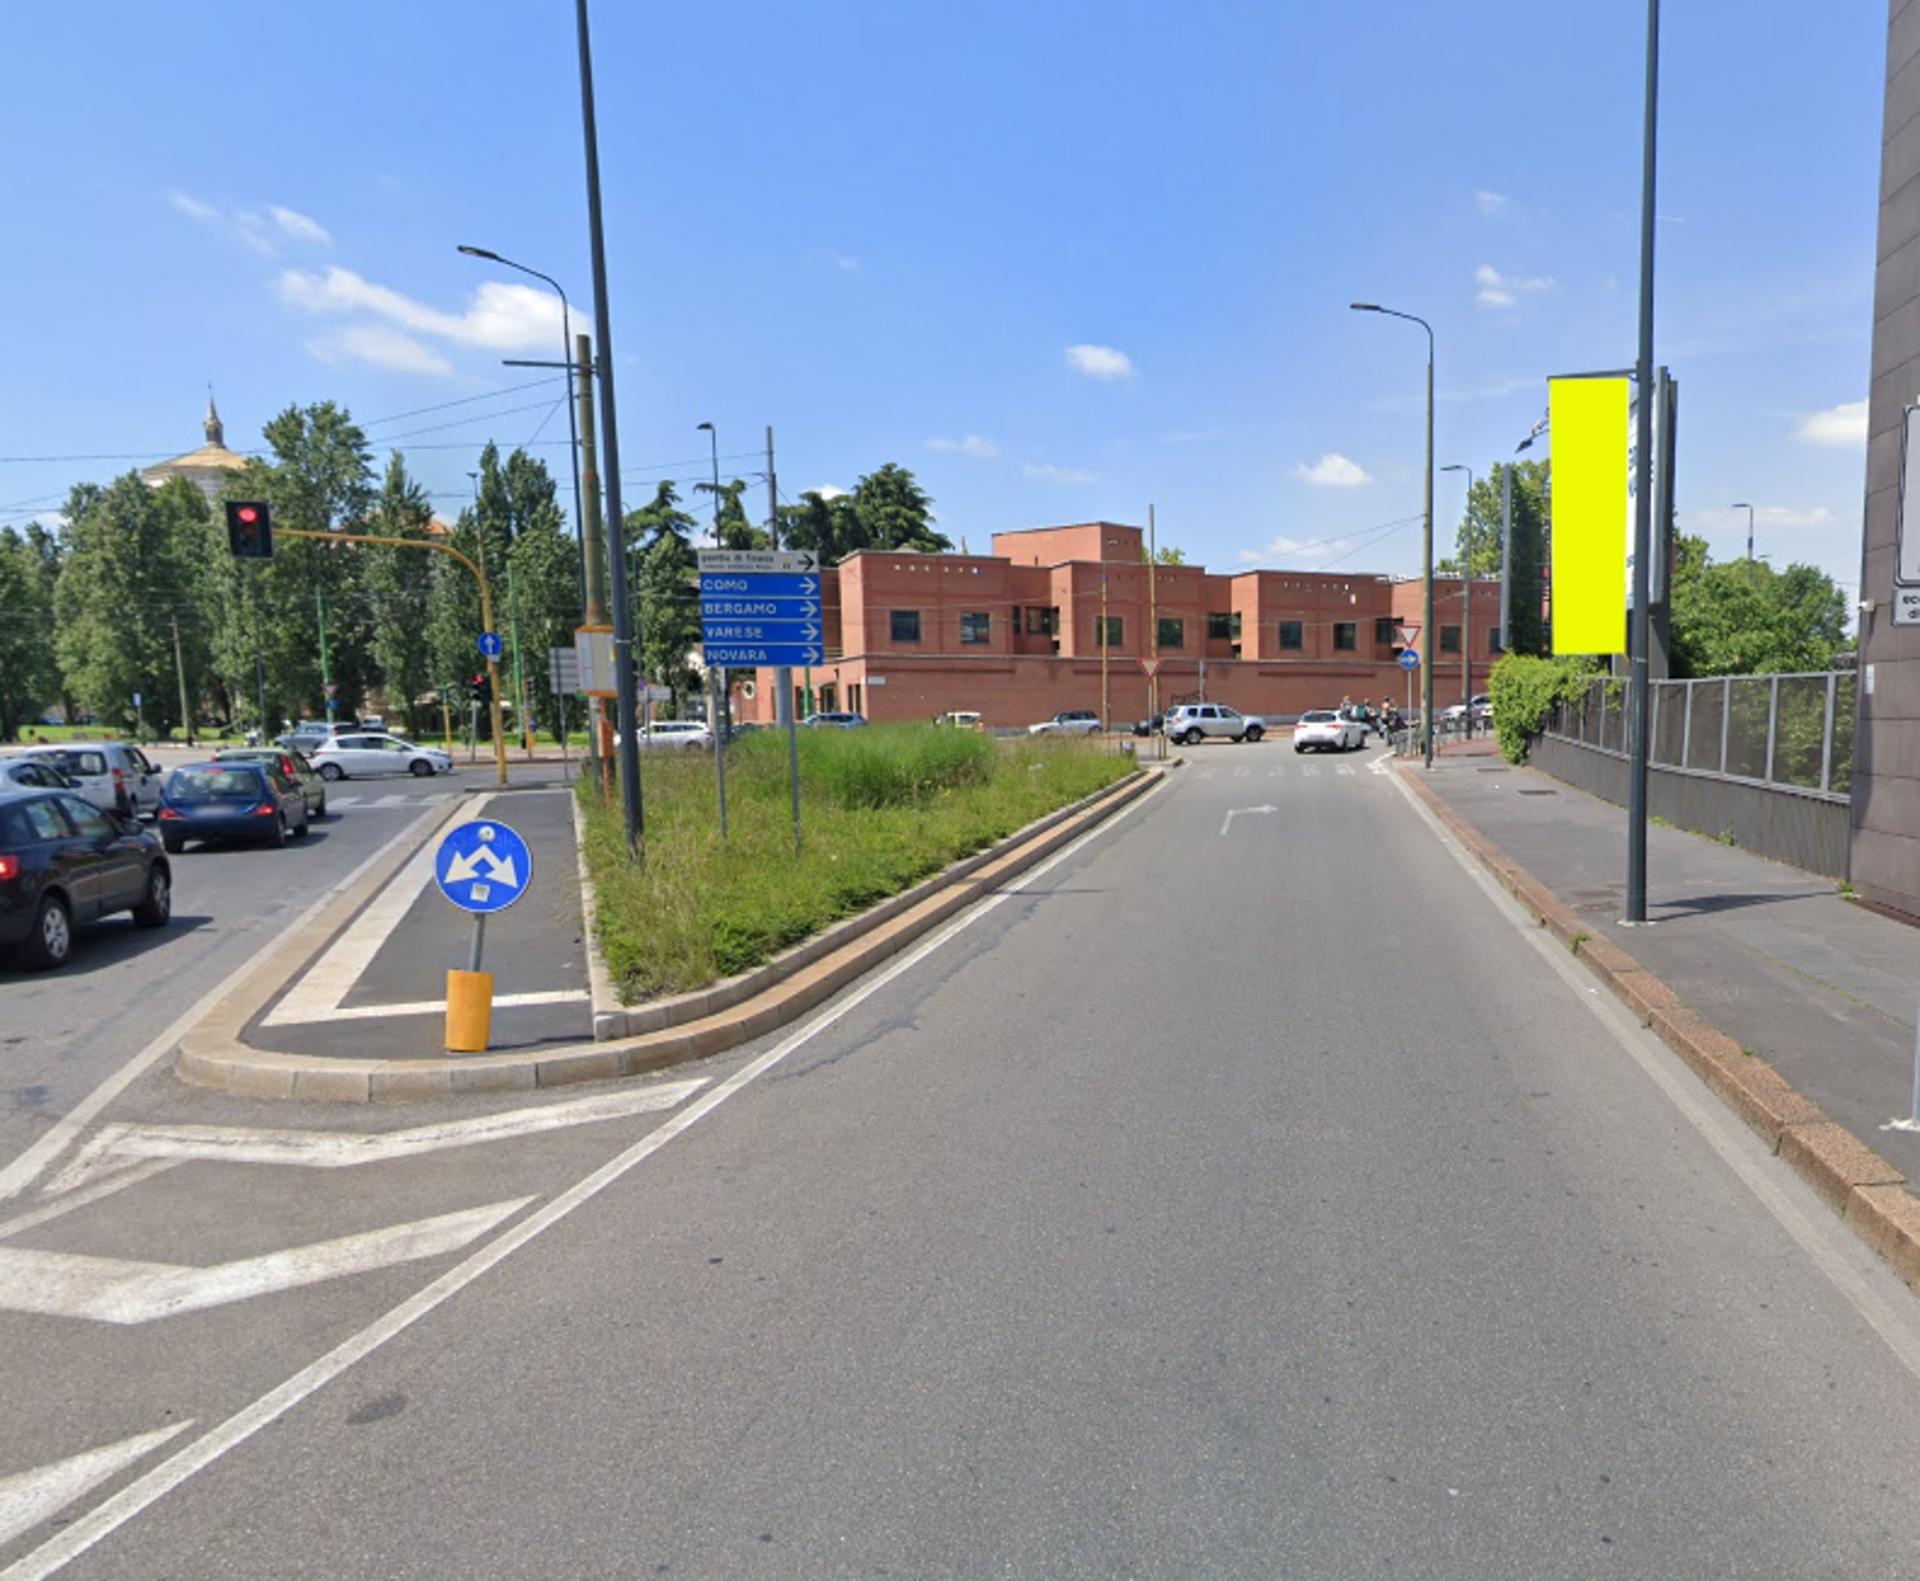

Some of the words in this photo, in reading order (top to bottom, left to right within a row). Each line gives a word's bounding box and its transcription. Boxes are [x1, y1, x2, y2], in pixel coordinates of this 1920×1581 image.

[702, 579, 748, 592] COMO
[704, 603, 777, 615] BERGAMO
[706, 626, 764, 638] VARESE
[707, 649, 767, 661] NOVARA
